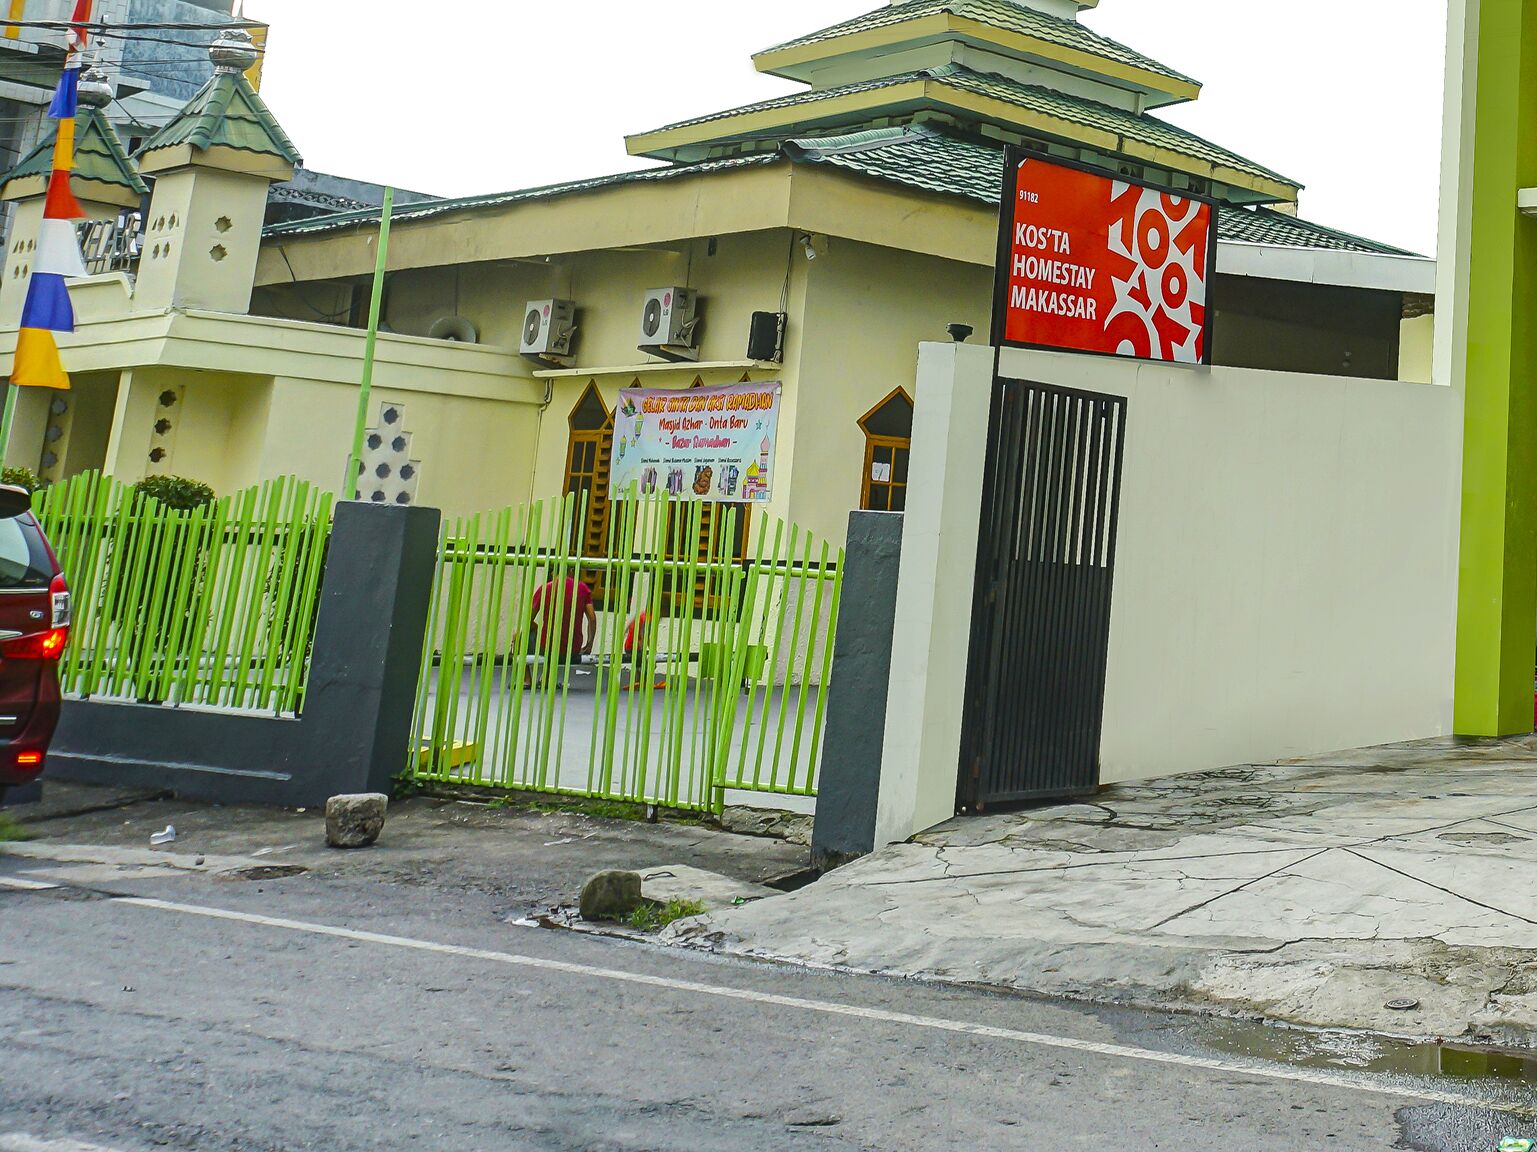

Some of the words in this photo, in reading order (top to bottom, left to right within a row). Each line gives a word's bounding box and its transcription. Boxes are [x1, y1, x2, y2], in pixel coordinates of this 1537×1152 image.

[1020, 189, 1039, 204] 91182
[1015, 222, 1070, 255] KOS'TA
[1013, 254, 1096, 290] HOMESTAY
[1010, 285, 1097, 320] MAKASSAR
[659, 417, 681, 434] Masjid
[682, 417, 703, 431] Azhar
[709, 415, 728, 429] Onta
[729, 415, 749, 429] Baru
